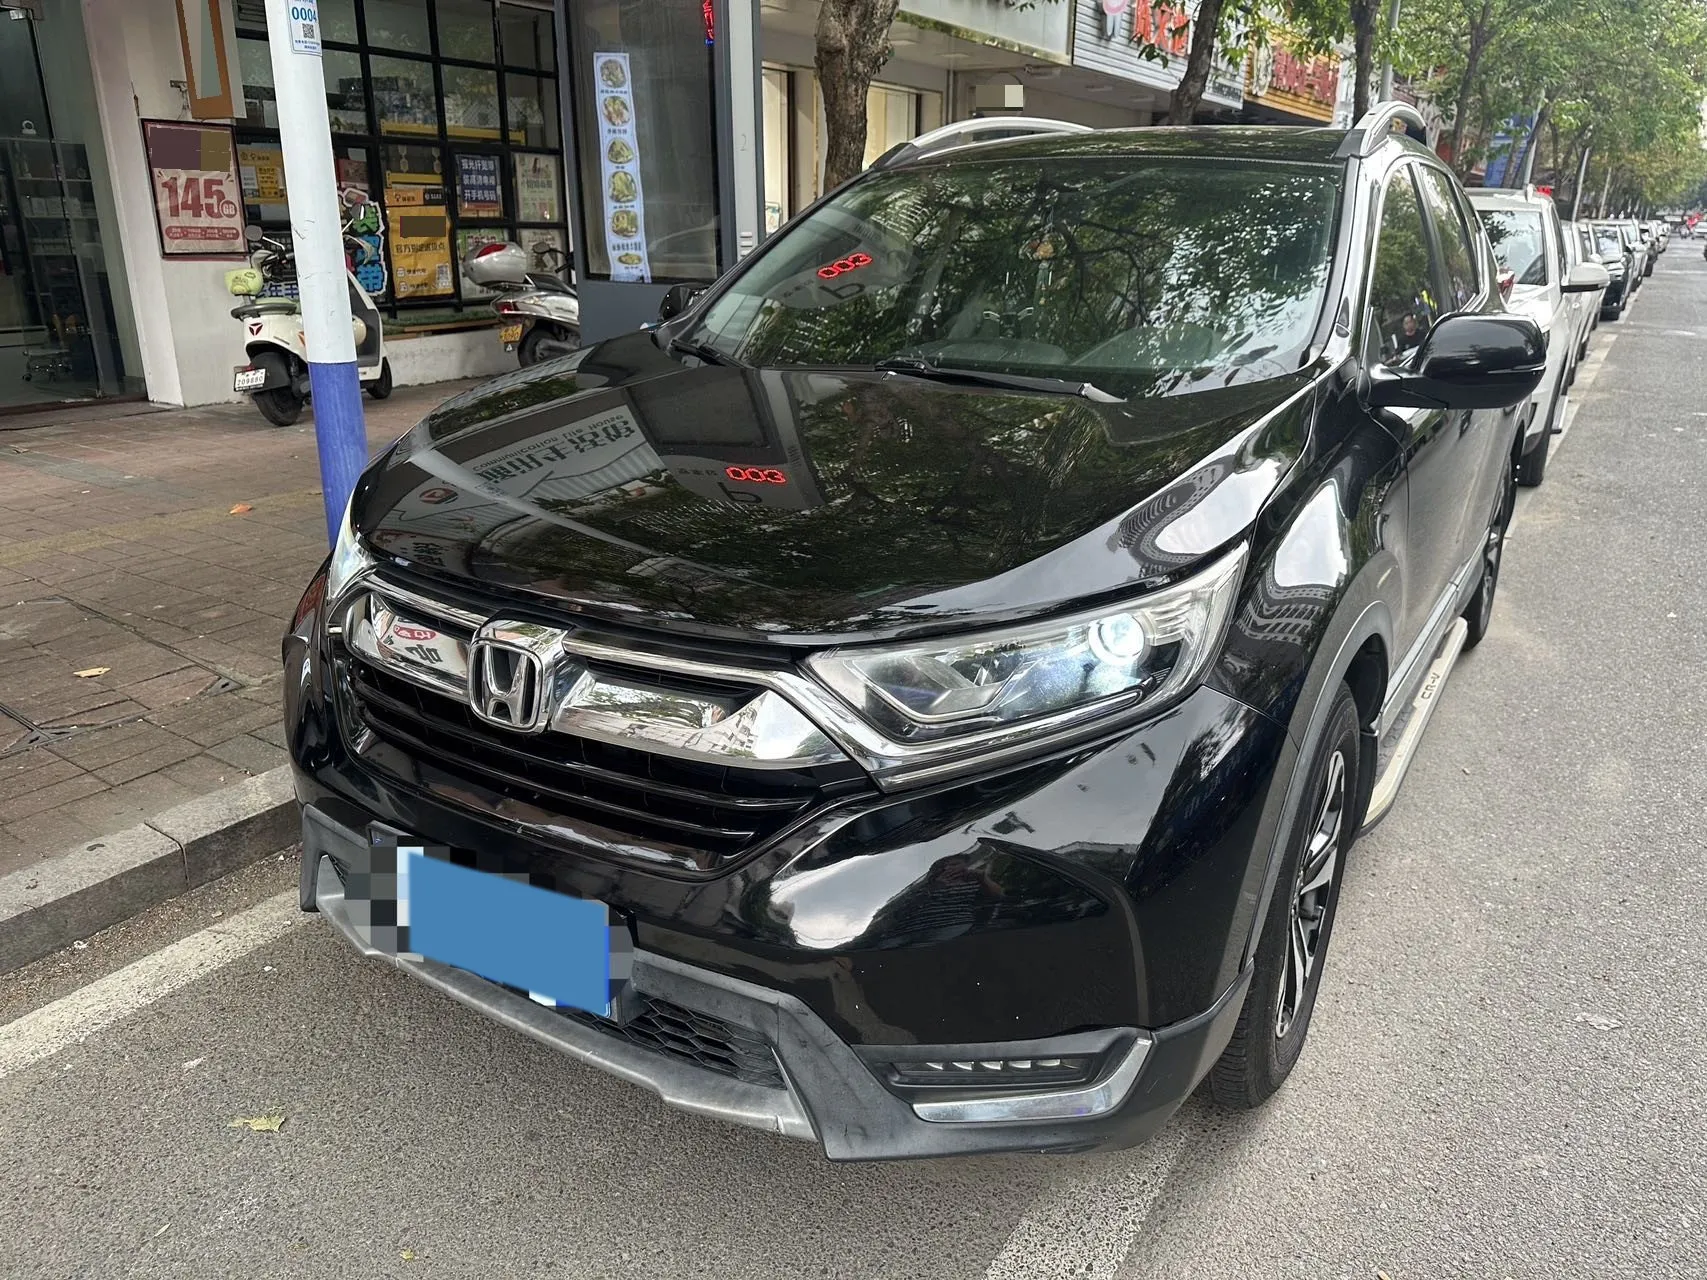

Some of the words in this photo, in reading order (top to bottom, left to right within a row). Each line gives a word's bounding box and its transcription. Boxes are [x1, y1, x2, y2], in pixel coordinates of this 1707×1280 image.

[291, 7, 317, 23] 0004
[161, 177, 226, 218] 145
[222, 202, 236, 216] GB
[1421, 672, 1441, 699] CR-V
